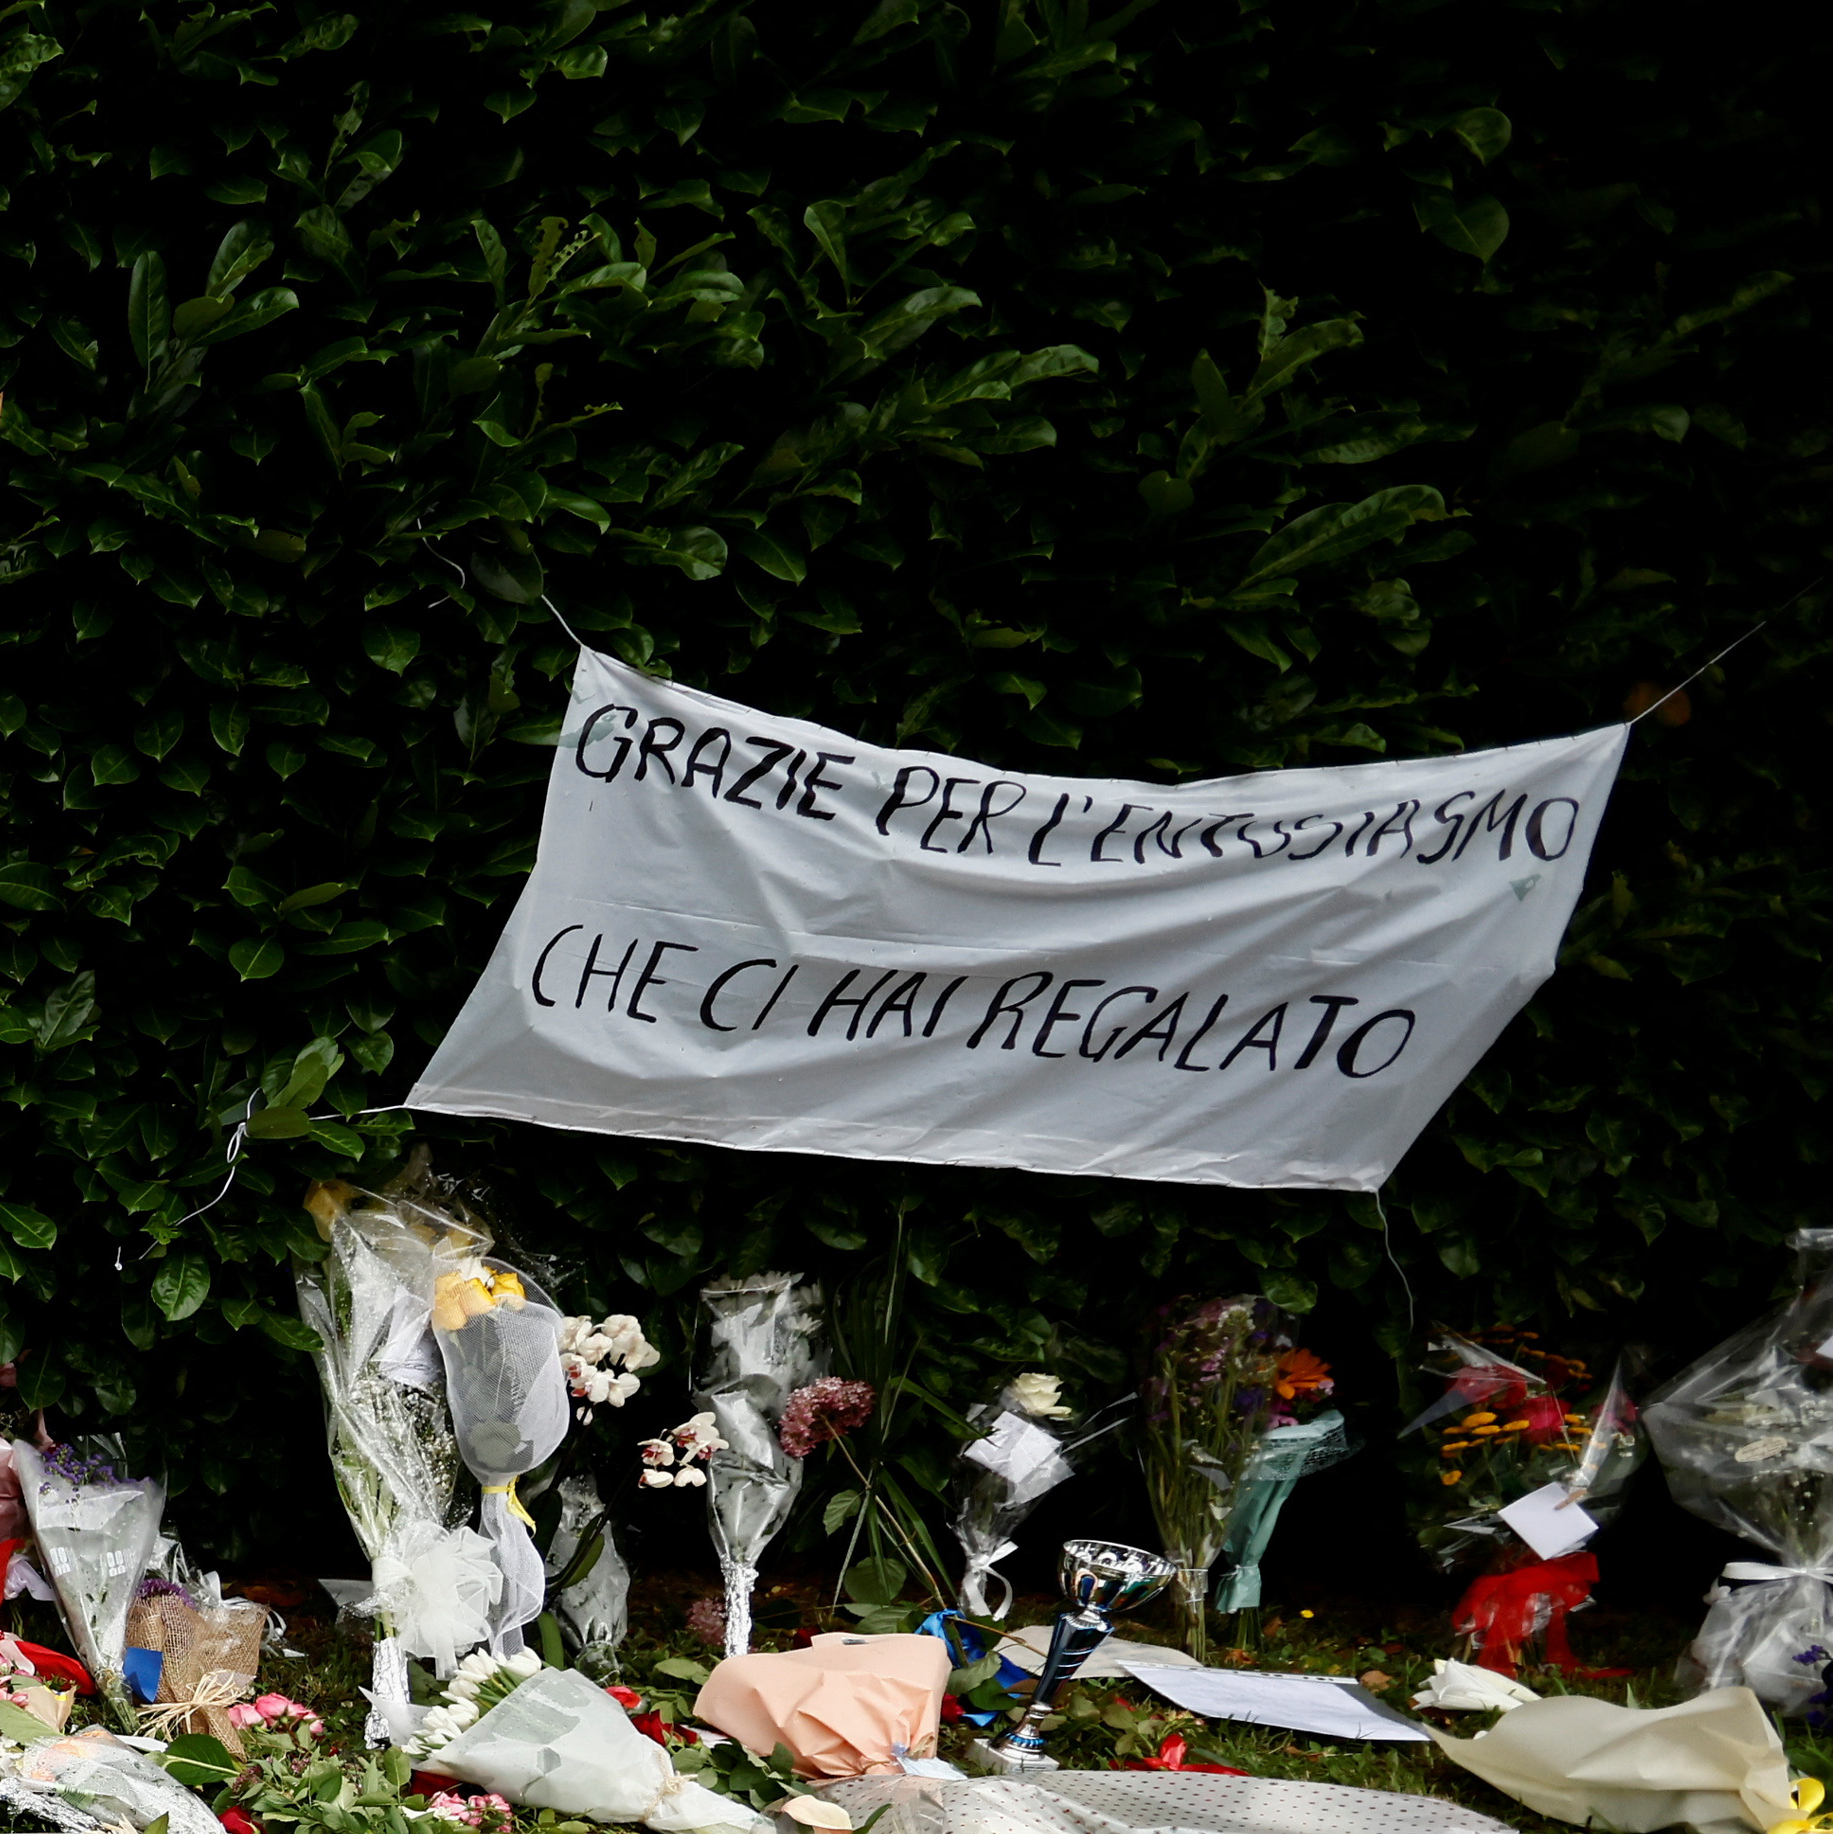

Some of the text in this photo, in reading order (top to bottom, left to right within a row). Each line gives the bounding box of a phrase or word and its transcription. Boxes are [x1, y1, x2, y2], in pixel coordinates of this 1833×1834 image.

[574, 703, 856, 822] GRAZIE
[877, 763, 1027, 857] PER
[531, 924, 1417, 1080] CHE CI HAI REGALATO
